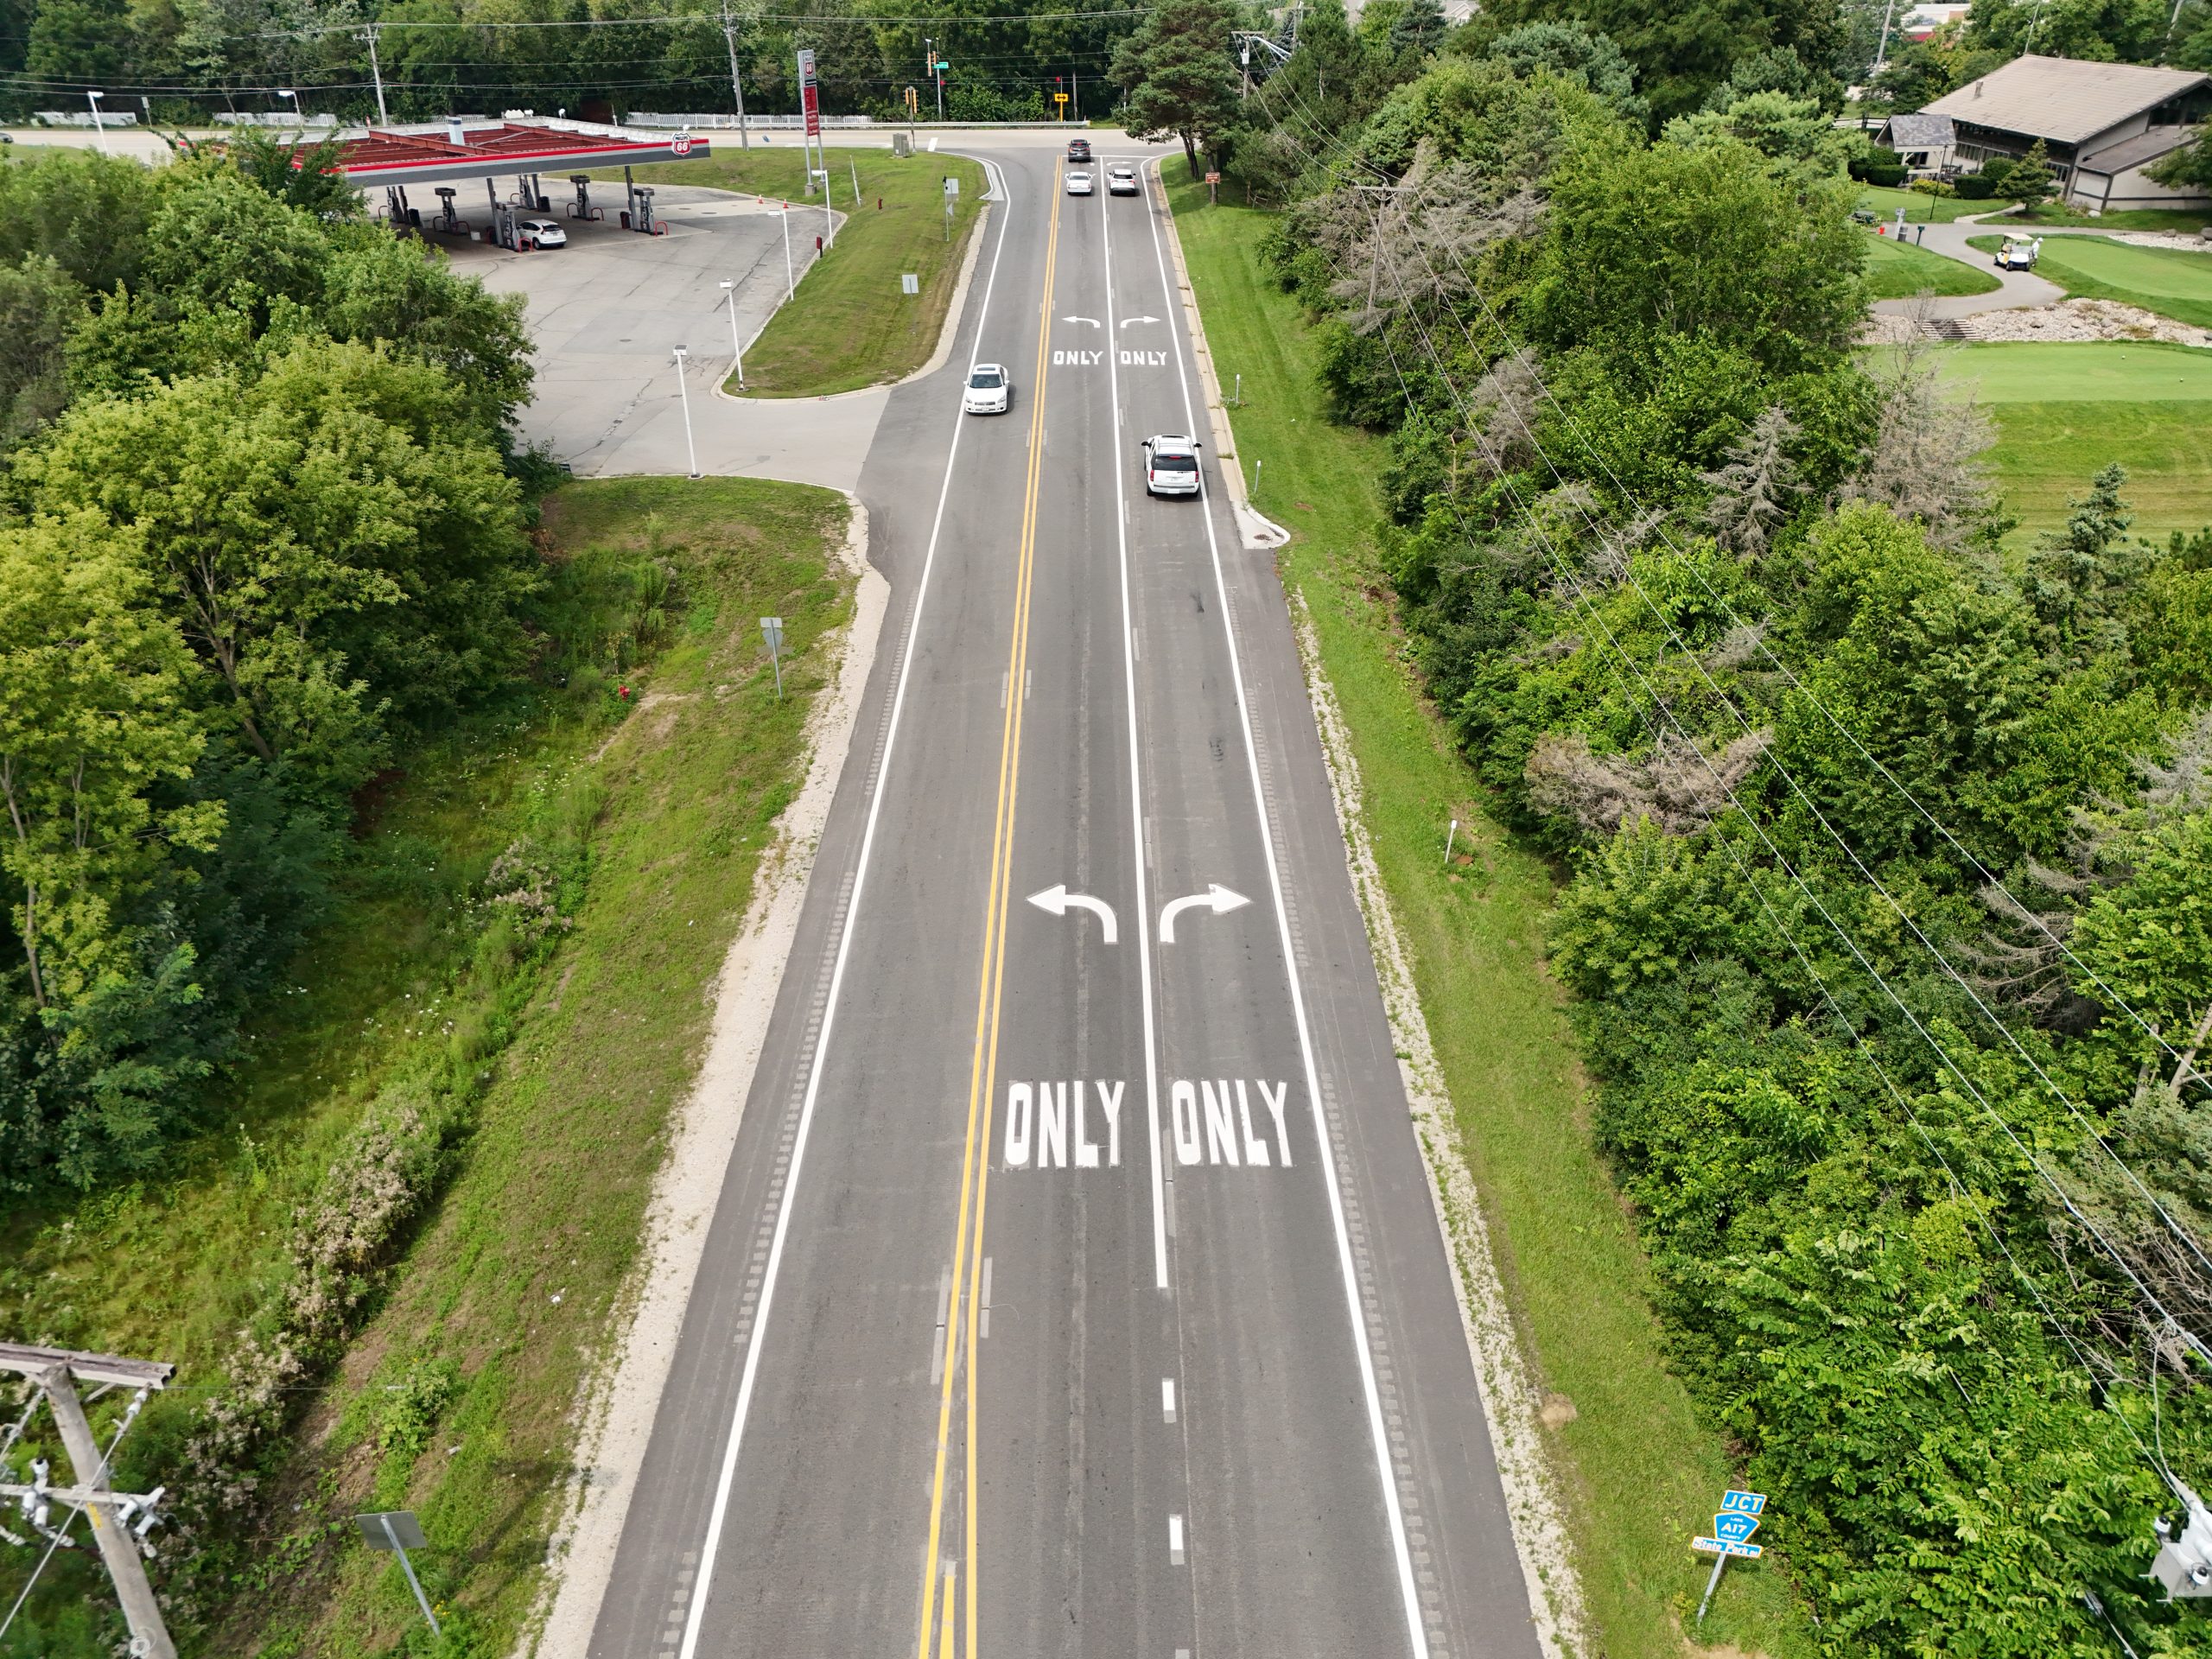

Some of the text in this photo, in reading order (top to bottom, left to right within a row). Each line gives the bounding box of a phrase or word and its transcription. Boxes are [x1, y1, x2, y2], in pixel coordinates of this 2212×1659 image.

[677, 142, 688, 151] 66
[1053, 350, 1103, 365] ONLY
[1120, 350, 1167, 365] ONLY
[1005, 1081, 1125, 1168] ONLY
[1172, 1079, 1294, 1167] ONLY
[1725, 1494, 1764, 1511] JCT
[1720, 1522, 1748, 1535] A17
[1694, 1538, 1723, 1552] State
[1725, 1542, 1749, 1555] Park
